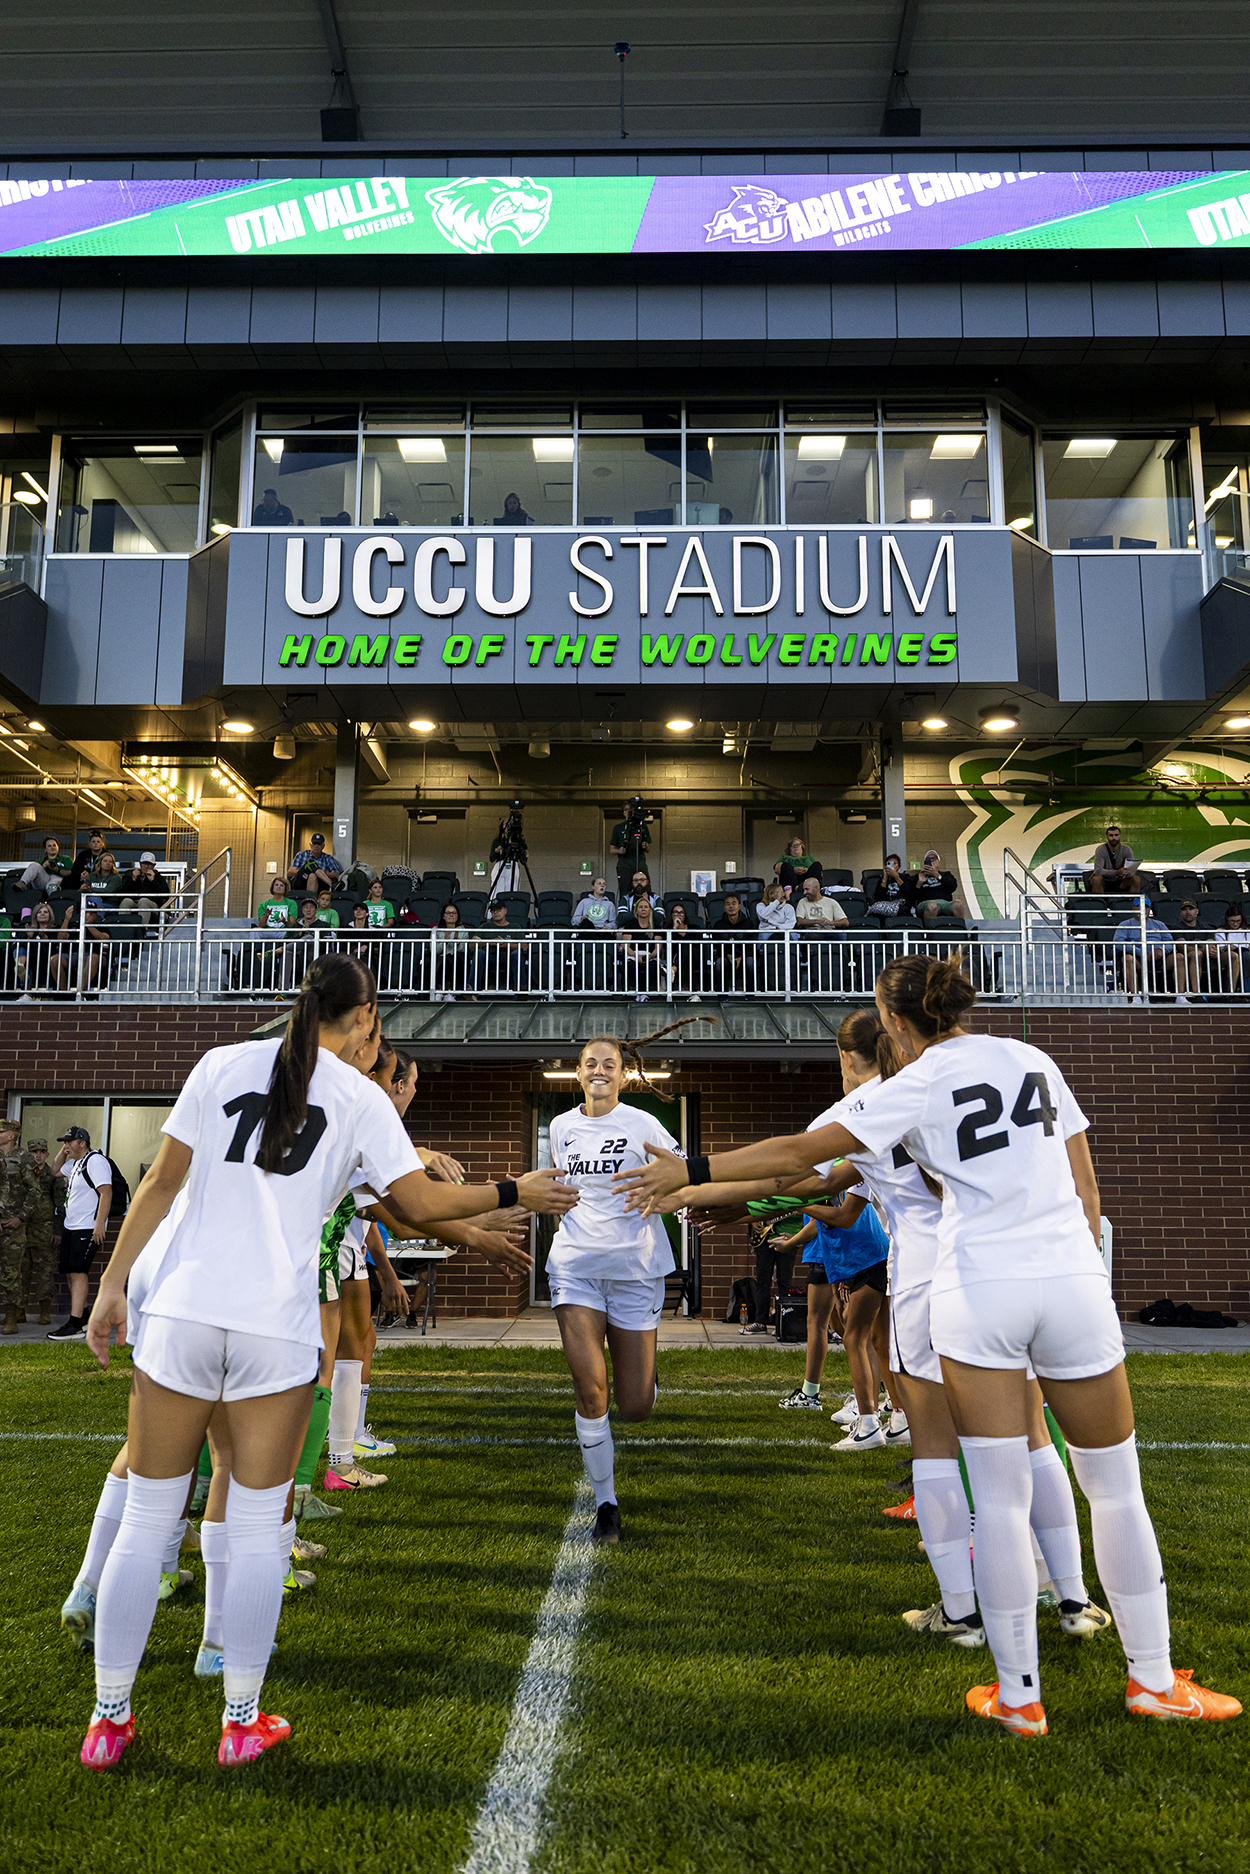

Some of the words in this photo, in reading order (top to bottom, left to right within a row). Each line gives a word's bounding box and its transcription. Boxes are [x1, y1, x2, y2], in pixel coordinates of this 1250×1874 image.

[225, 199, 306, 253] UTAH
[304, 176, 410, 232] VALLEY
[785, 174, 912, 243] ABILENE
[343, 211, 415, 241] WOLVERINES
[713, 212, 784, 240] ACU
[833, 220, 892, 247] WILDCATS
[285, 536, 532, 616] UCCU
[569, 535, 957, 616] STADIUM
[279, 634, 422, 666] HOME
[442, 634, 505, 666] OF
[525, 634, 619, 666] THE
[641, 633, 957, 666] WOLVERINES
[338, 824, 347, 838] 5
[891, 824, 900, 837] 5
[952, 1072, 1057, 1162] 24
[567, 1153, 581, 1162] THE
[600, 1138, 628, 1154] 22
[567, 1158, 625, 1176] VALLEY
